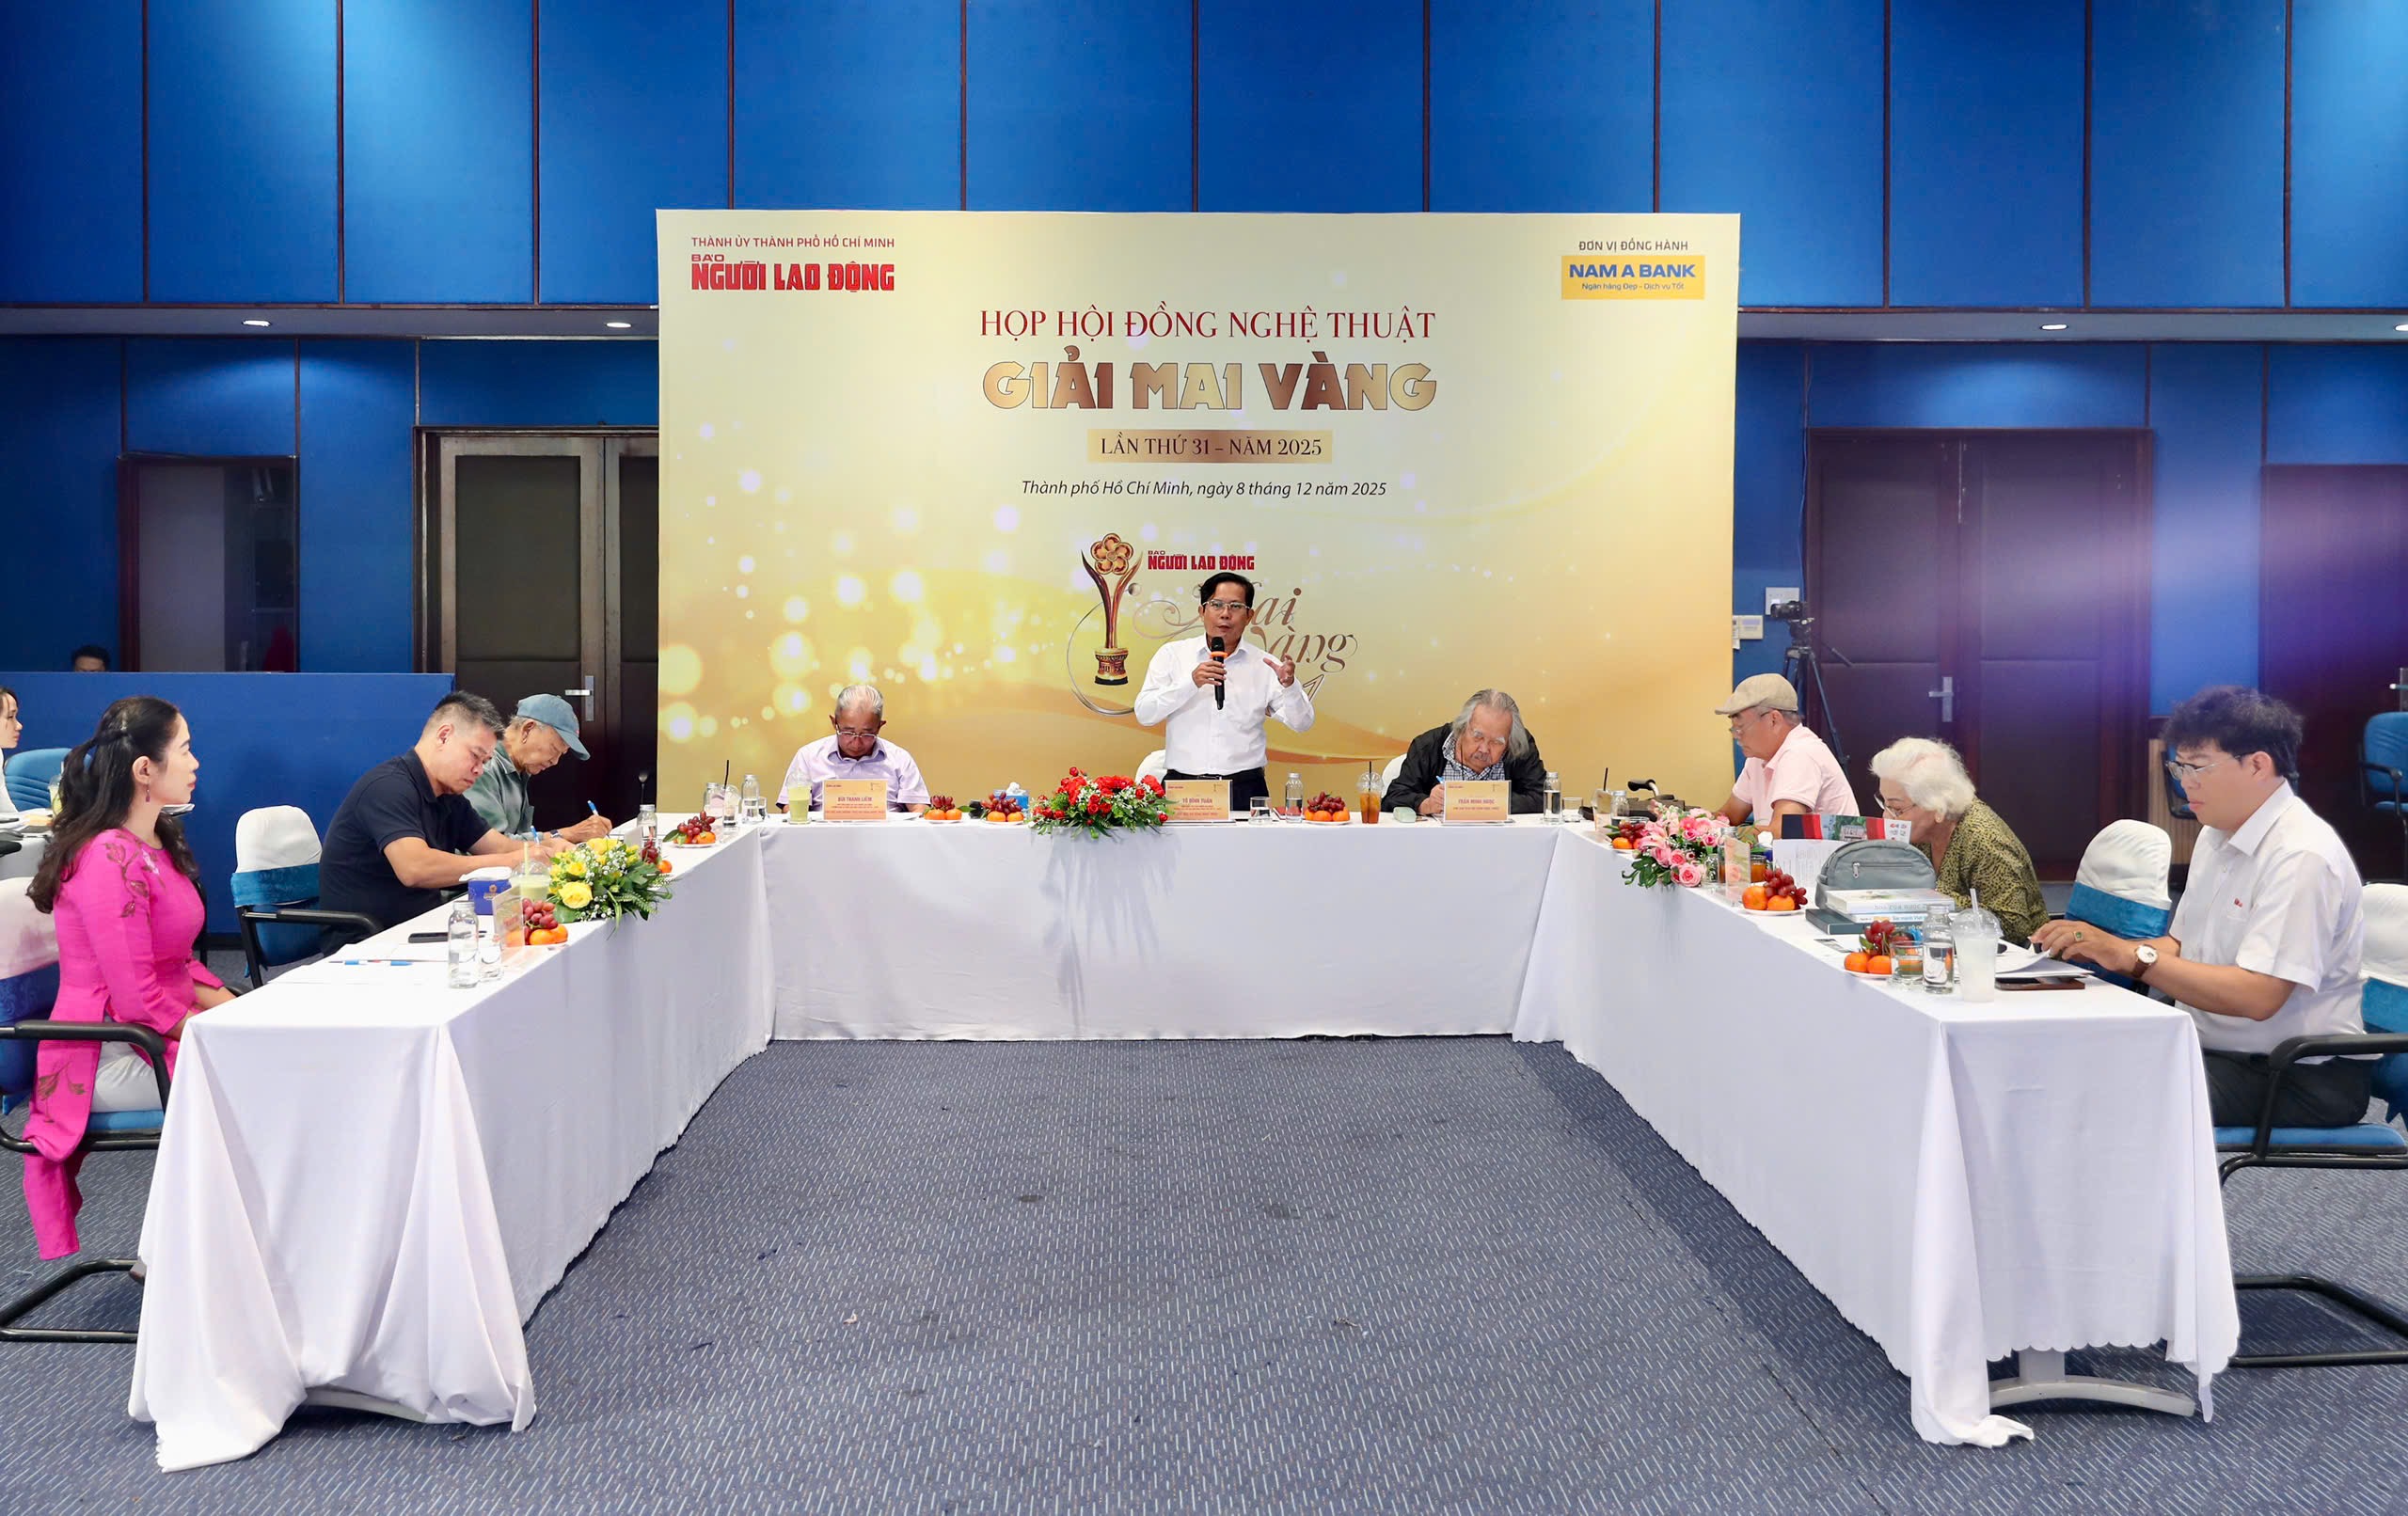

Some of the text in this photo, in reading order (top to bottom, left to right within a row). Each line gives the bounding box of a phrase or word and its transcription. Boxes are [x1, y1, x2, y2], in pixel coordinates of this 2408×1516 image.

[692, 235, 732, 247] THÀNH
[736, 234, 751, 247] ỦY
[753, 235, 793, 247] THÀNH
[843, 236, 861, 247] CHÍ
[864, 238, 895, 247] MINH
[1578, 239, 1603, 251] ĐƠN
[1607, 241, 1617, 253] VỊ
[1656, 239, 1688, 251] HÀNH
[691, 261, 895, 292] NGƯỜI LAO ĐỘNG
[1569, 264, 1696, 278] NAM A BANK
[980, 300, 1436, 343] HỌP HỘI ĐỒNG NGHỆ THUẬT
[982, 344, 1437, 411] GIẢI MAI VÀNG
[1101, 432, 1139, 455] LẦN
[1144, 434, 1187, 455] THỨ
[1192, 438, 1210, 455] 31
[1229, 435, 1272, 455] NĂM
[1277, 438, 1322, 456] 2025
[1022, 479, 1387, 498] Thành phố Hồ Chí Minh, ngày 8 tháng 12 năm 2025
[1148, 554, 1255, 571] NGƯỜI LAO ĐỘNG
